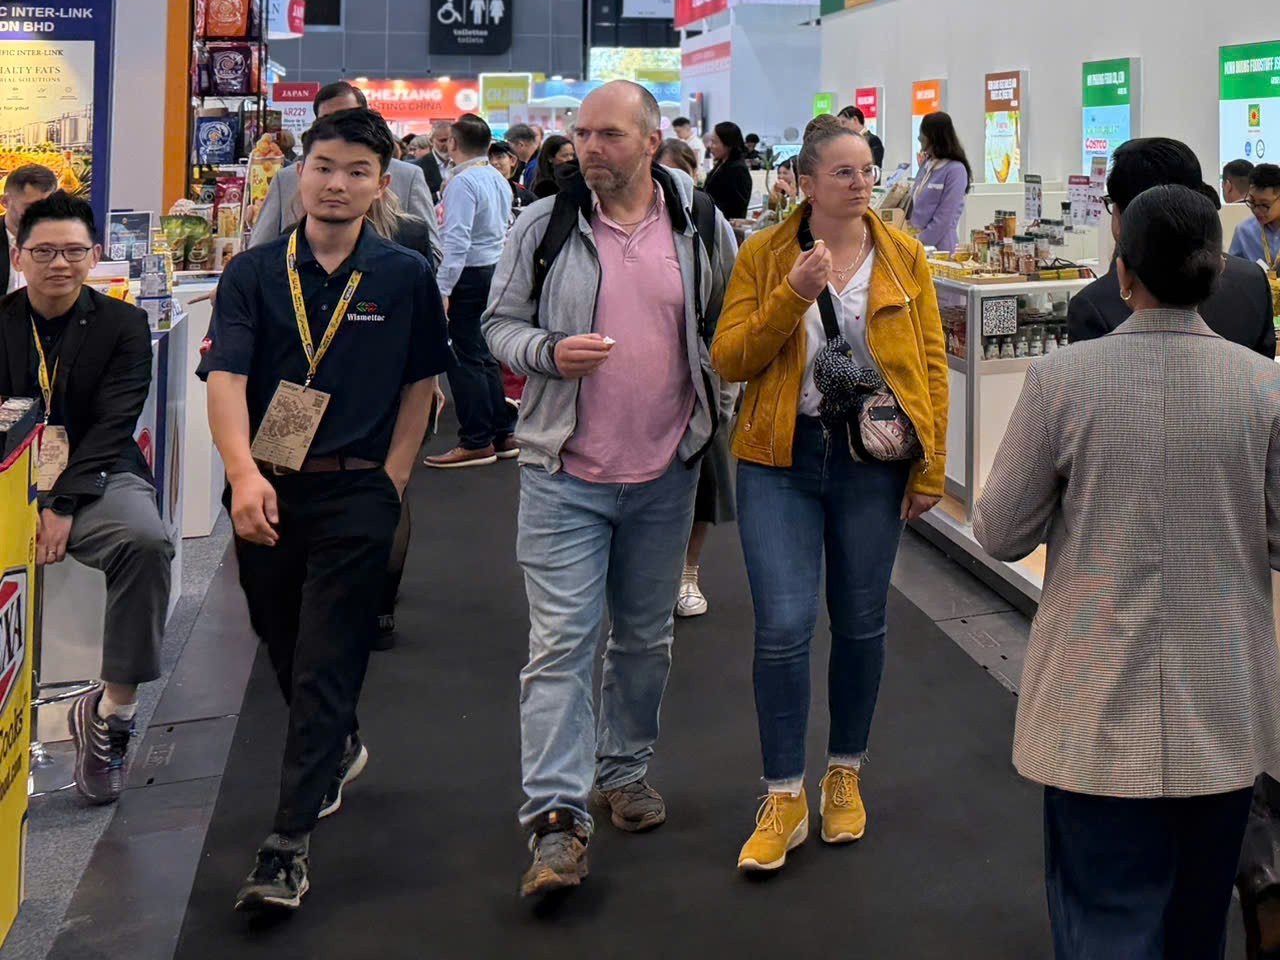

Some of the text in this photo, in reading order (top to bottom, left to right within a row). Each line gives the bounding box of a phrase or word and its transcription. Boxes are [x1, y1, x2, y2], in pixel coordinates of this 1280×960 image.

[11, 6, 93, 18] INTER-LINK
[23, 21, 55, 32] BHD
[17, 49, 64, 57] INTER-LINK
[35, 66, 61, 75] FATS
[408, 102, 442, 111] CHINA
